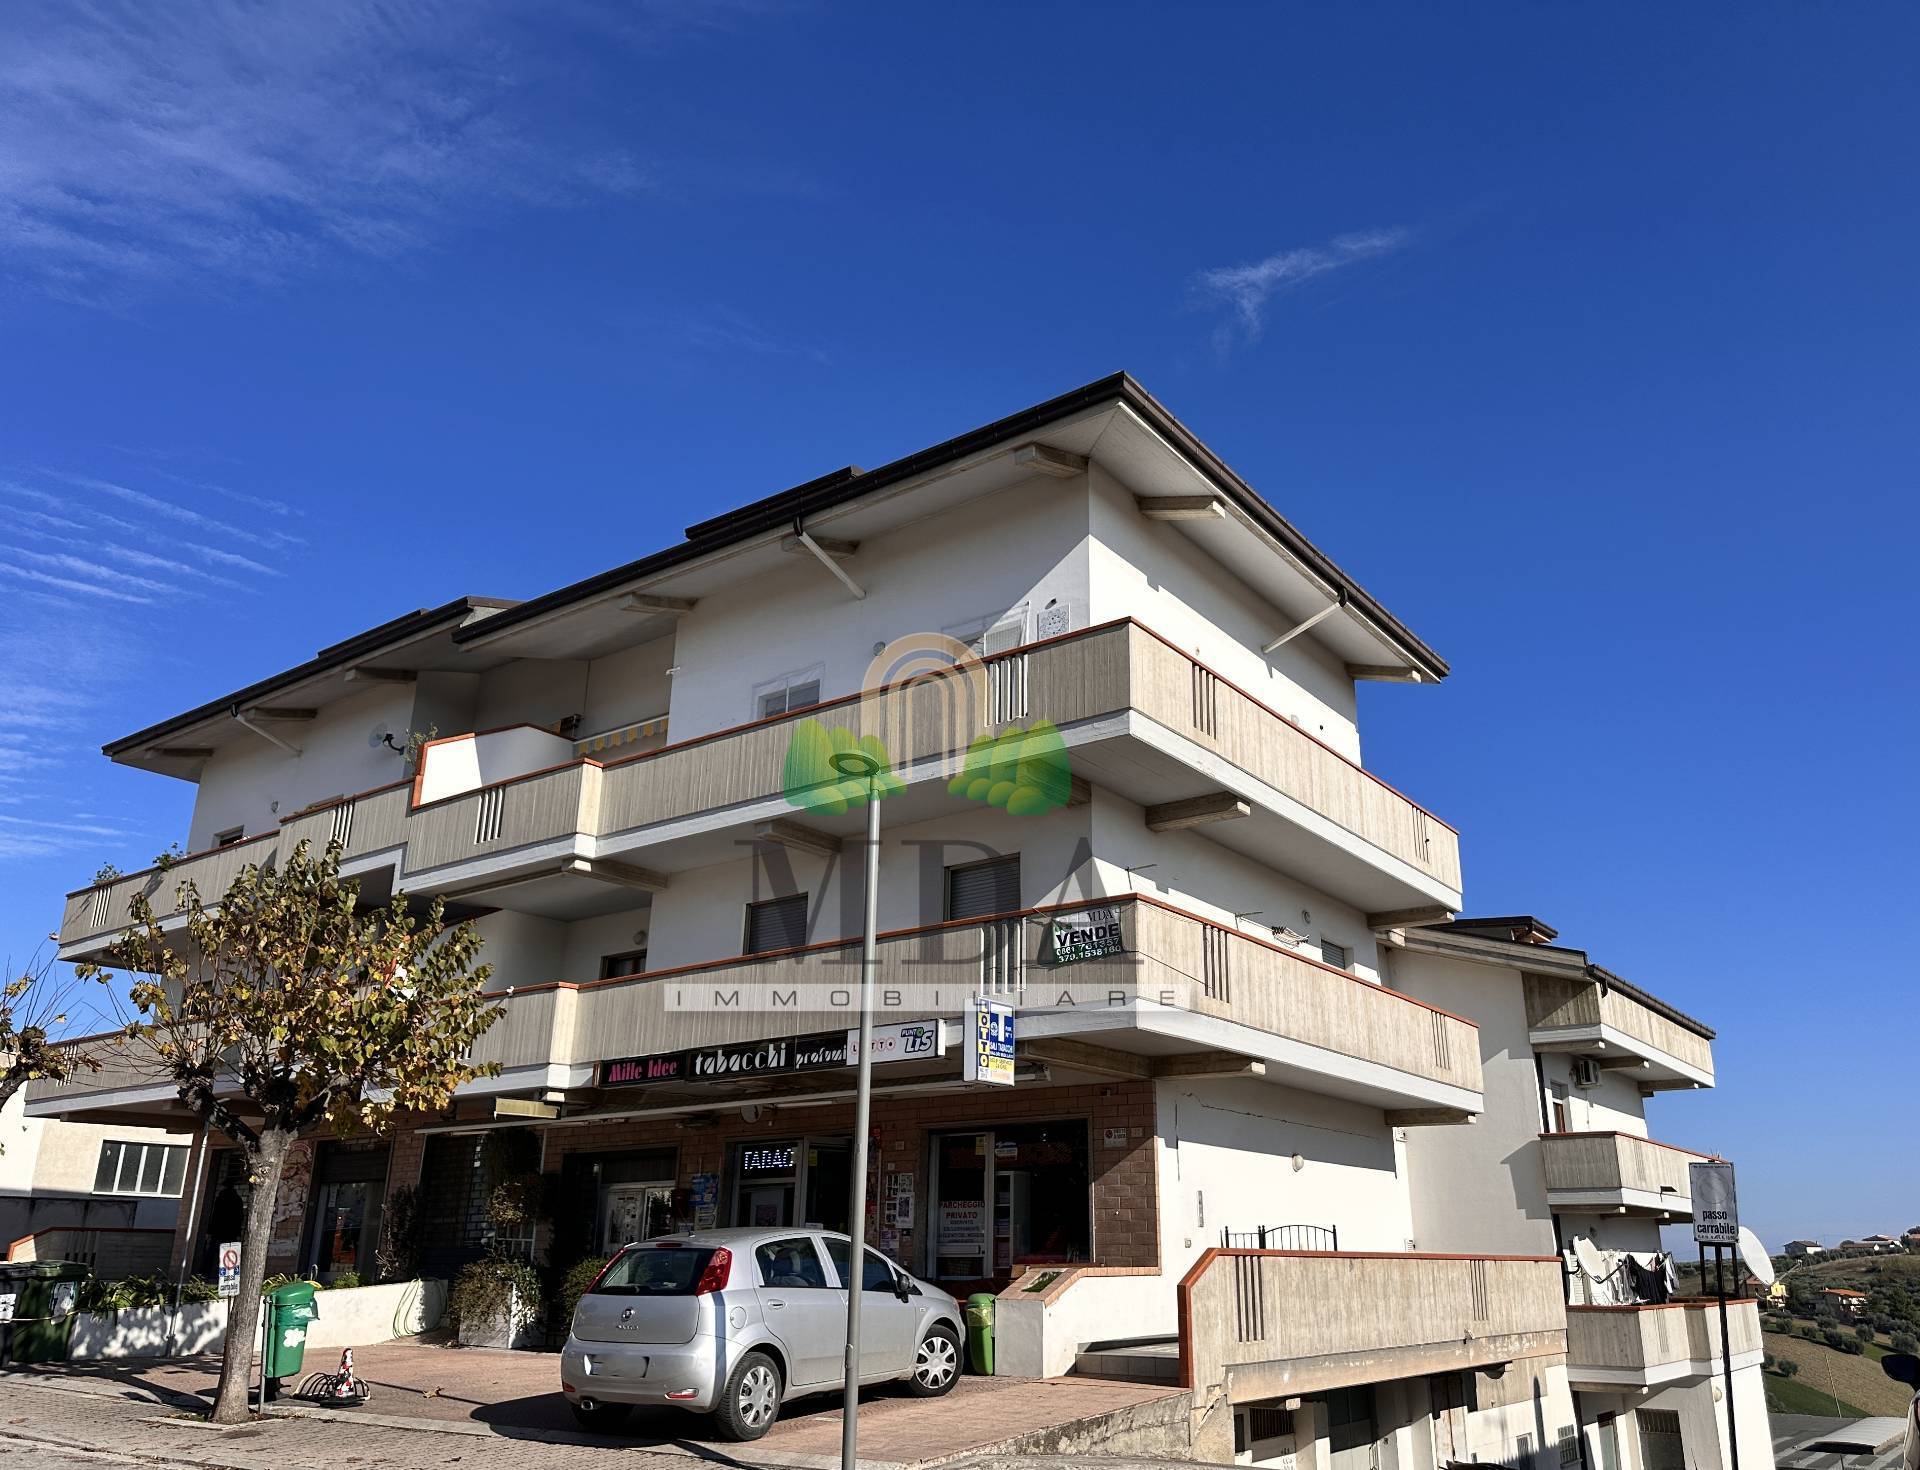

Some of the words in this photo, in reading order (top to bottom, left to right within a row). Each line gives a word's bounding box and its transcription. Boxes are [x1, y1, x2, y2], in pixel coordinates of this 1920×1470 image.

[1056, 923, 1119, 946] VENDE
[980, 1000, 988, 1067] LOTTO
[851, 1038, 895, 1054] LTTO
[695, 1042, 786, 1075] tabacchi
[608, 1061, 642, 1082] Mille
[648, 1059, 678, 1078] Idee
[945, 1211, 977, 1219] PRIVATO
[1703, 1211, 1727, 1221] passo
[1697, 1223, 1735, 1234] carrabile
